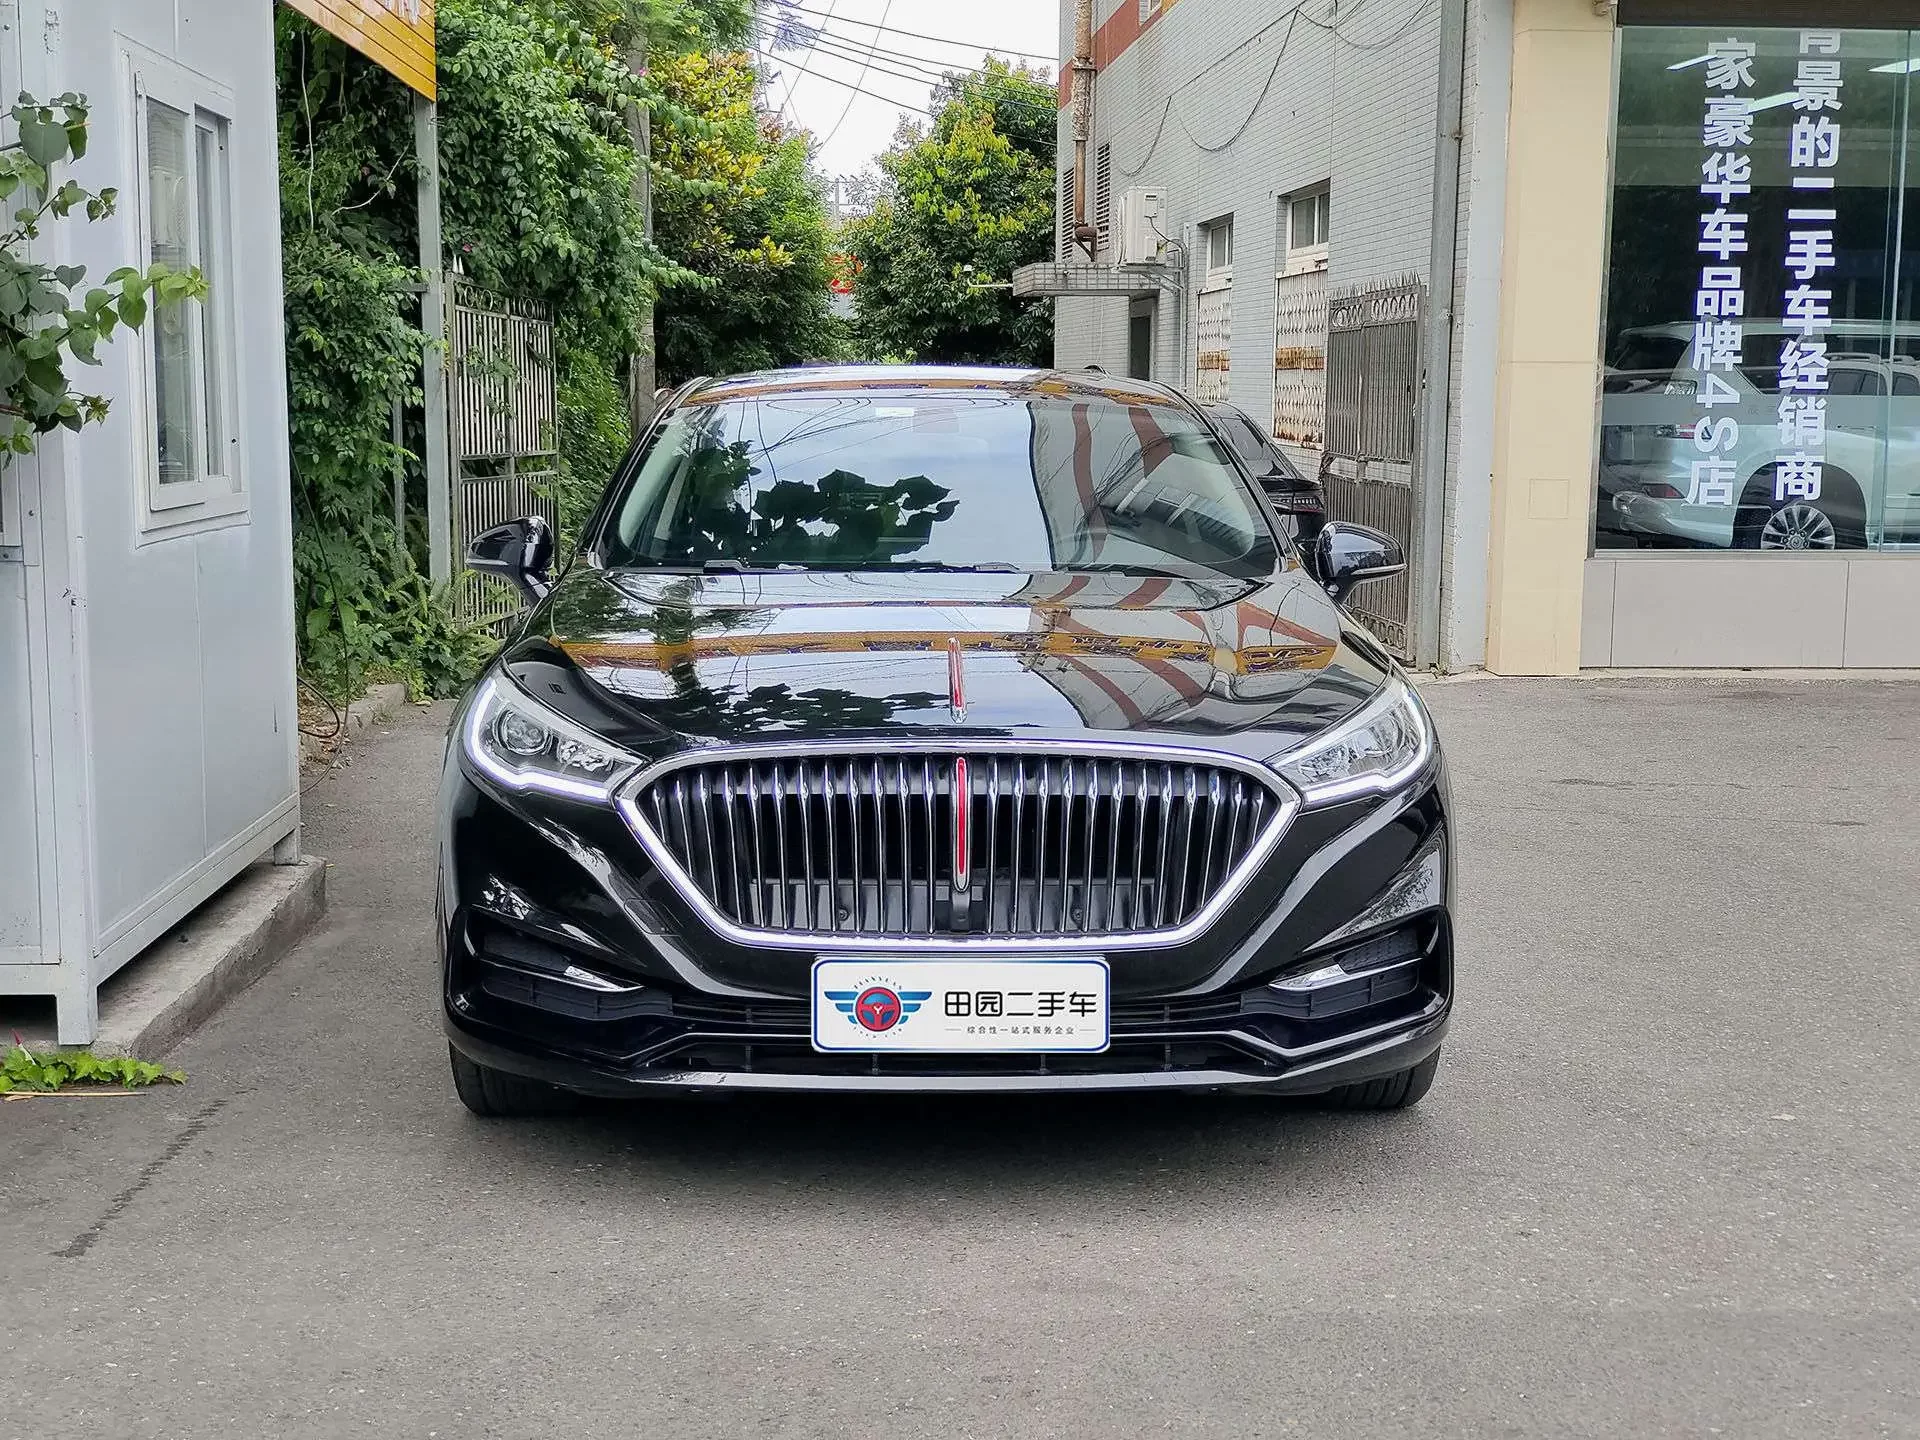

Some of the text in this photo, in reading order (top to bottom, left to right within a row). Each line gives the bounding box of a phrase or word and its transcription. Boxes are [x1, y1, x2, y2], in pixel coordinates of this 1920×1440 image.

[1682, 37, 1756, 505] 家豪华车品牌4S店
[945, 991, 1097, 1017] 田园二手车
[967, 1026, 1074, 1035] 综合性一站式服务企业
